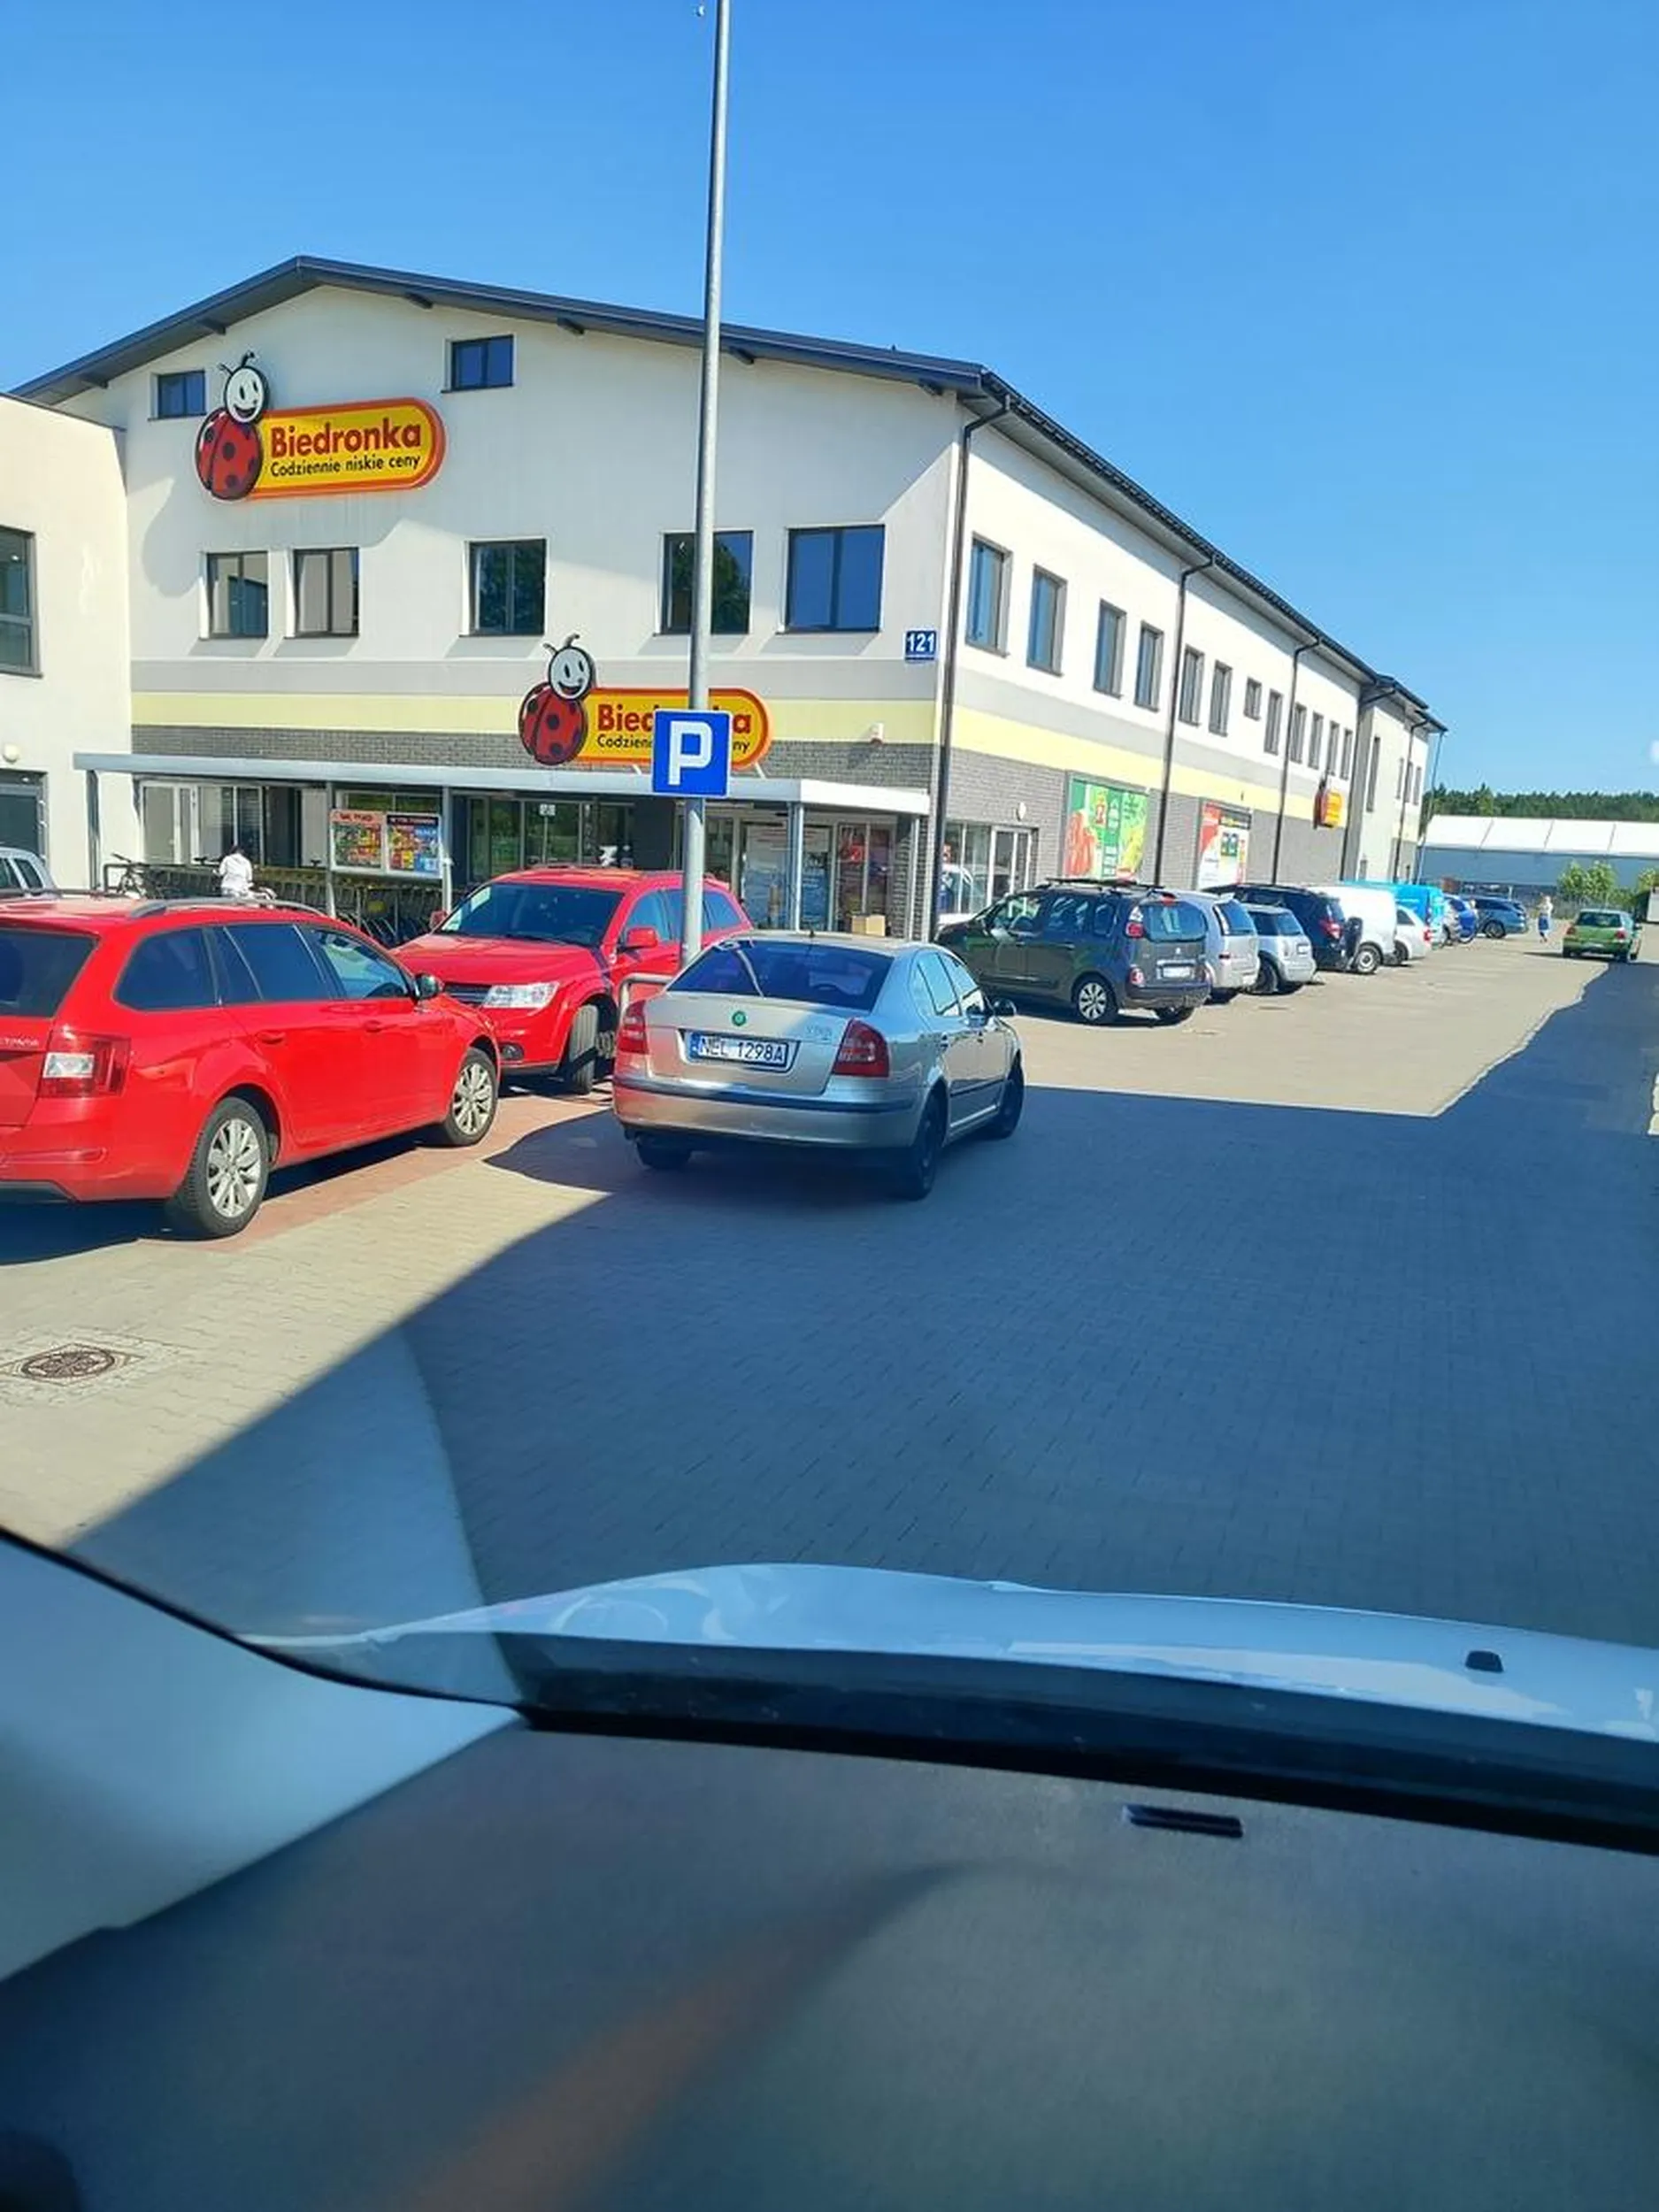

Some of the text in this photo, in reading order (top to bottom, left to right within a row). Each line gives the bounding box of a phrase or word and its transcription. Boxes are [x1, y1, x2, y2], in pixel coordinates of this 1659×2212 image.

[271, 418, 421, 457] Biedronka
[270, 455, 420, 478] Codziennie niskie ceny
[907, 633, 934, 653] 121
[668, 721, 712, 785] P
[699, 1037, 783, 1062] NEL 1298A
